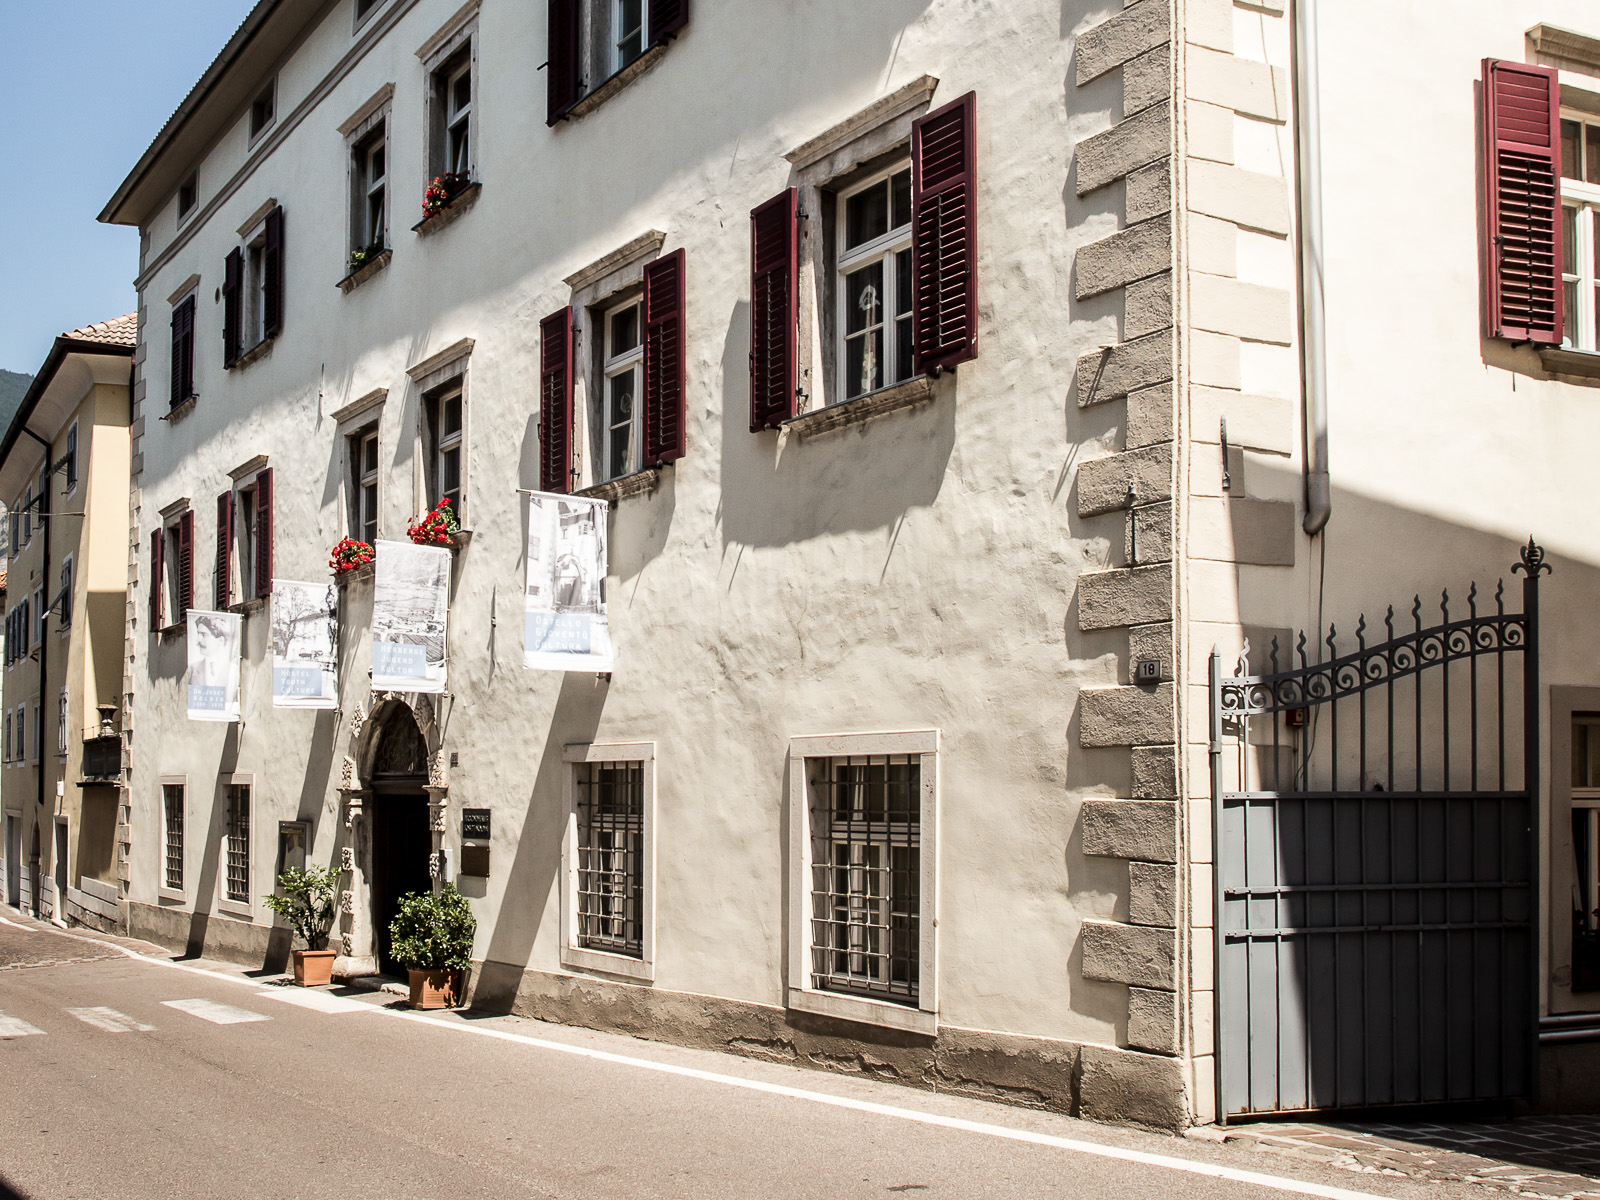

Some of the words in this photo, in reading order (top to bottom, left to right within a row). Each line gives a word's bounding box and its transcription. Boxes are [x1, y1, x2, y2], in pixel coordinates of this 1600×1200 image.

[535, 615, 582, 628] OSTELLO
[534, 640, 582, 650] CULTURA
[380, 655, 414, 665] JUGEND
[280, 669, 310, 678] HOSTEL
[380, 664, 413, 674] KULTUR
[1143, 663, 1155, 676] 18
[280, 686, 316, 694] CULTURE
